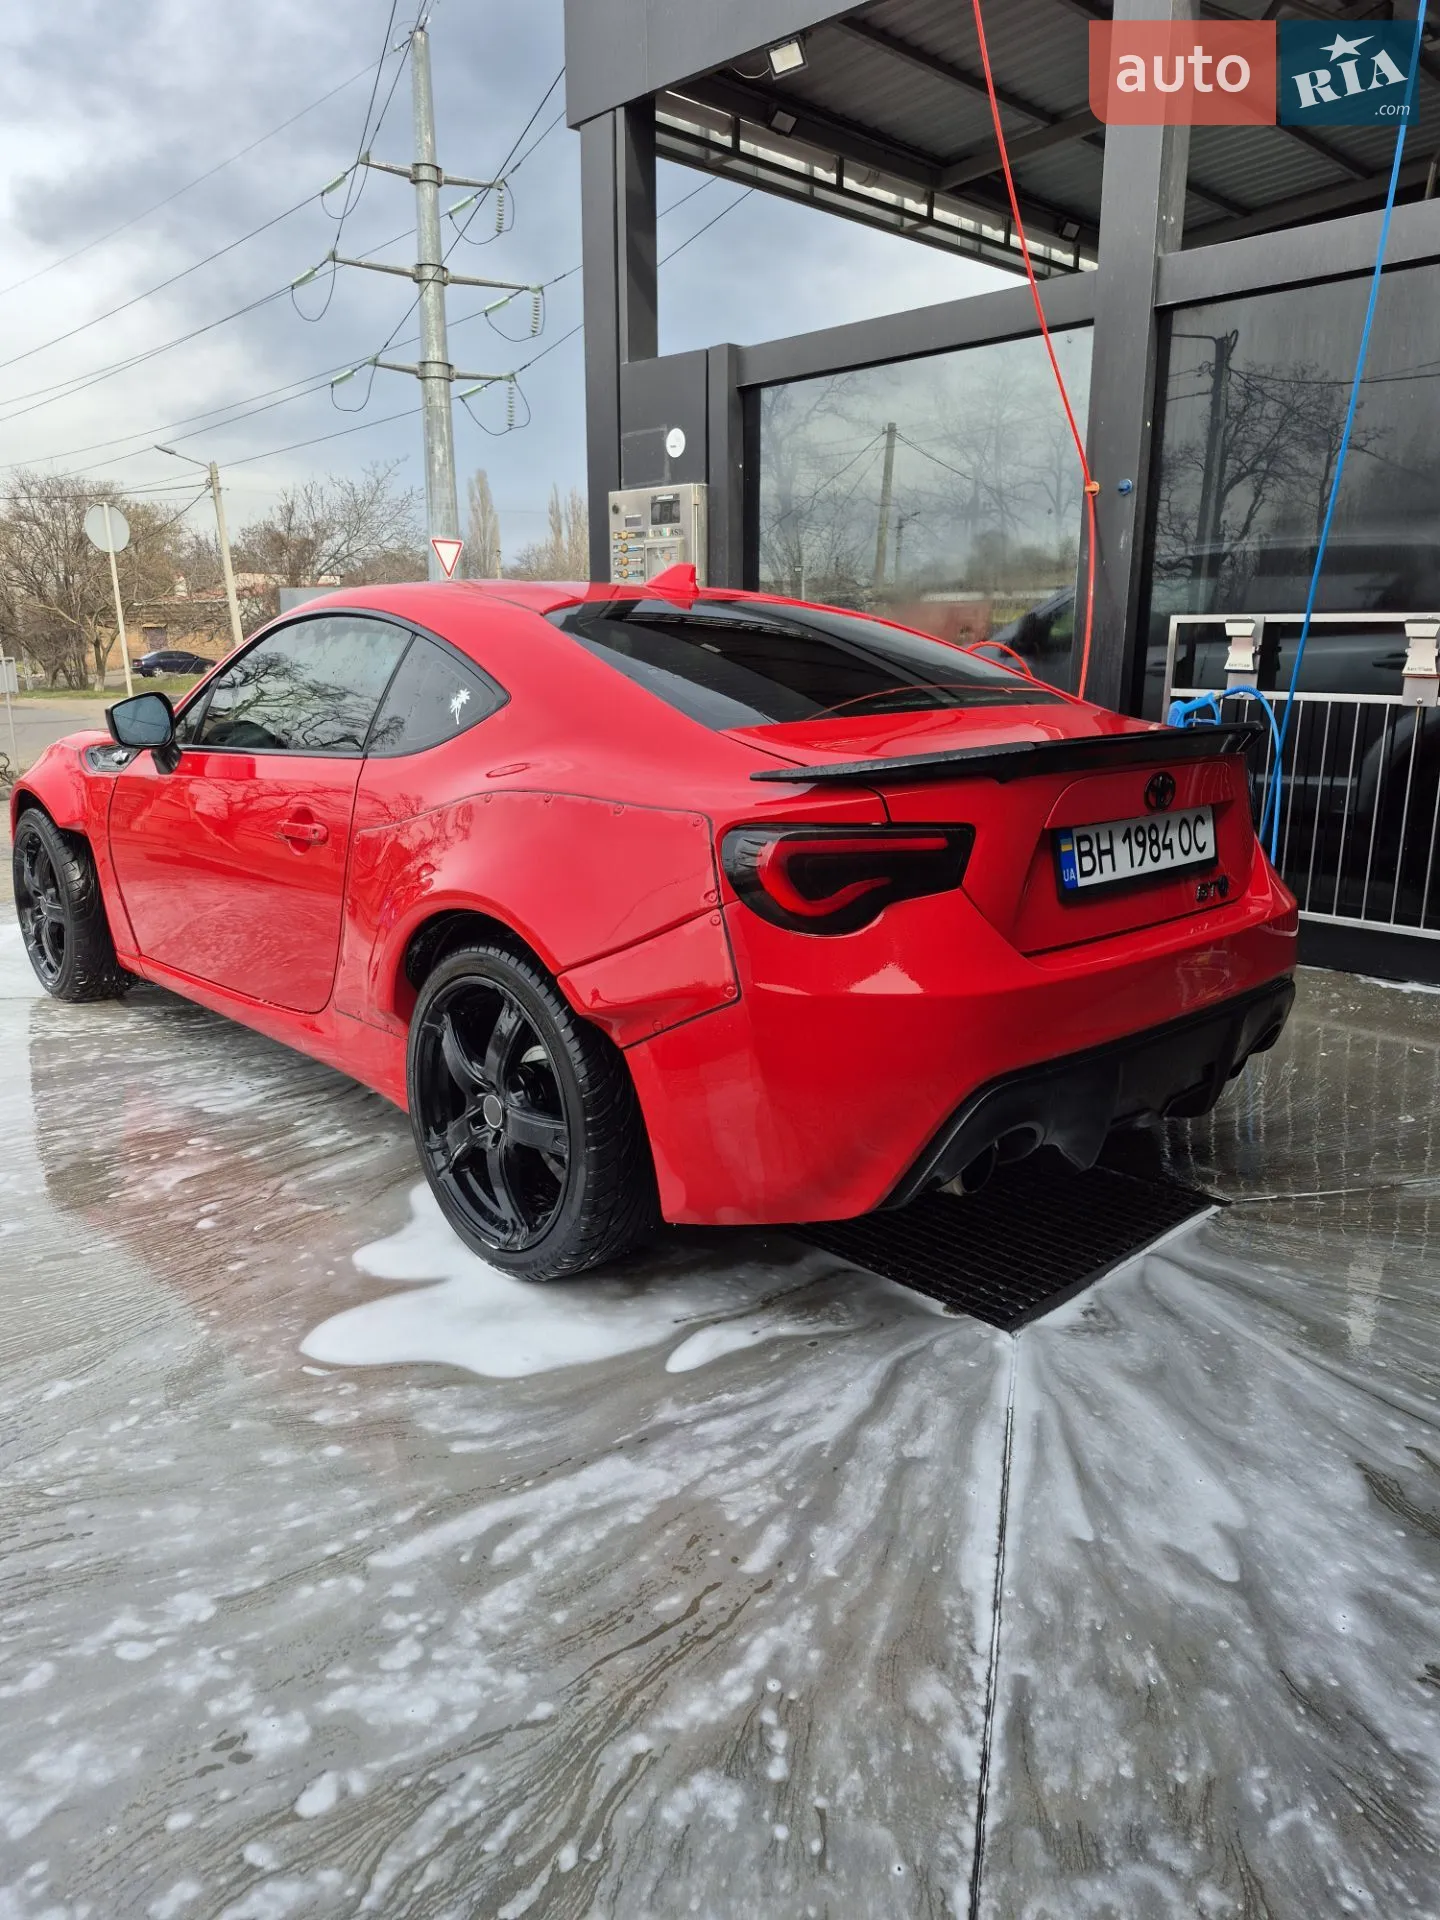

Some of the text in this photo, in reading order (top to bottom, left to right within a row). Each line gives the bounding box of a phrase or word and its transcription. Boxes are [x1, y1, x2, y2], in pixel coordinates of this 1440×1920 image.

[1076, 814, 1207, 879] BH 1984 OC
[1063, 868, 1076, 882] UA
